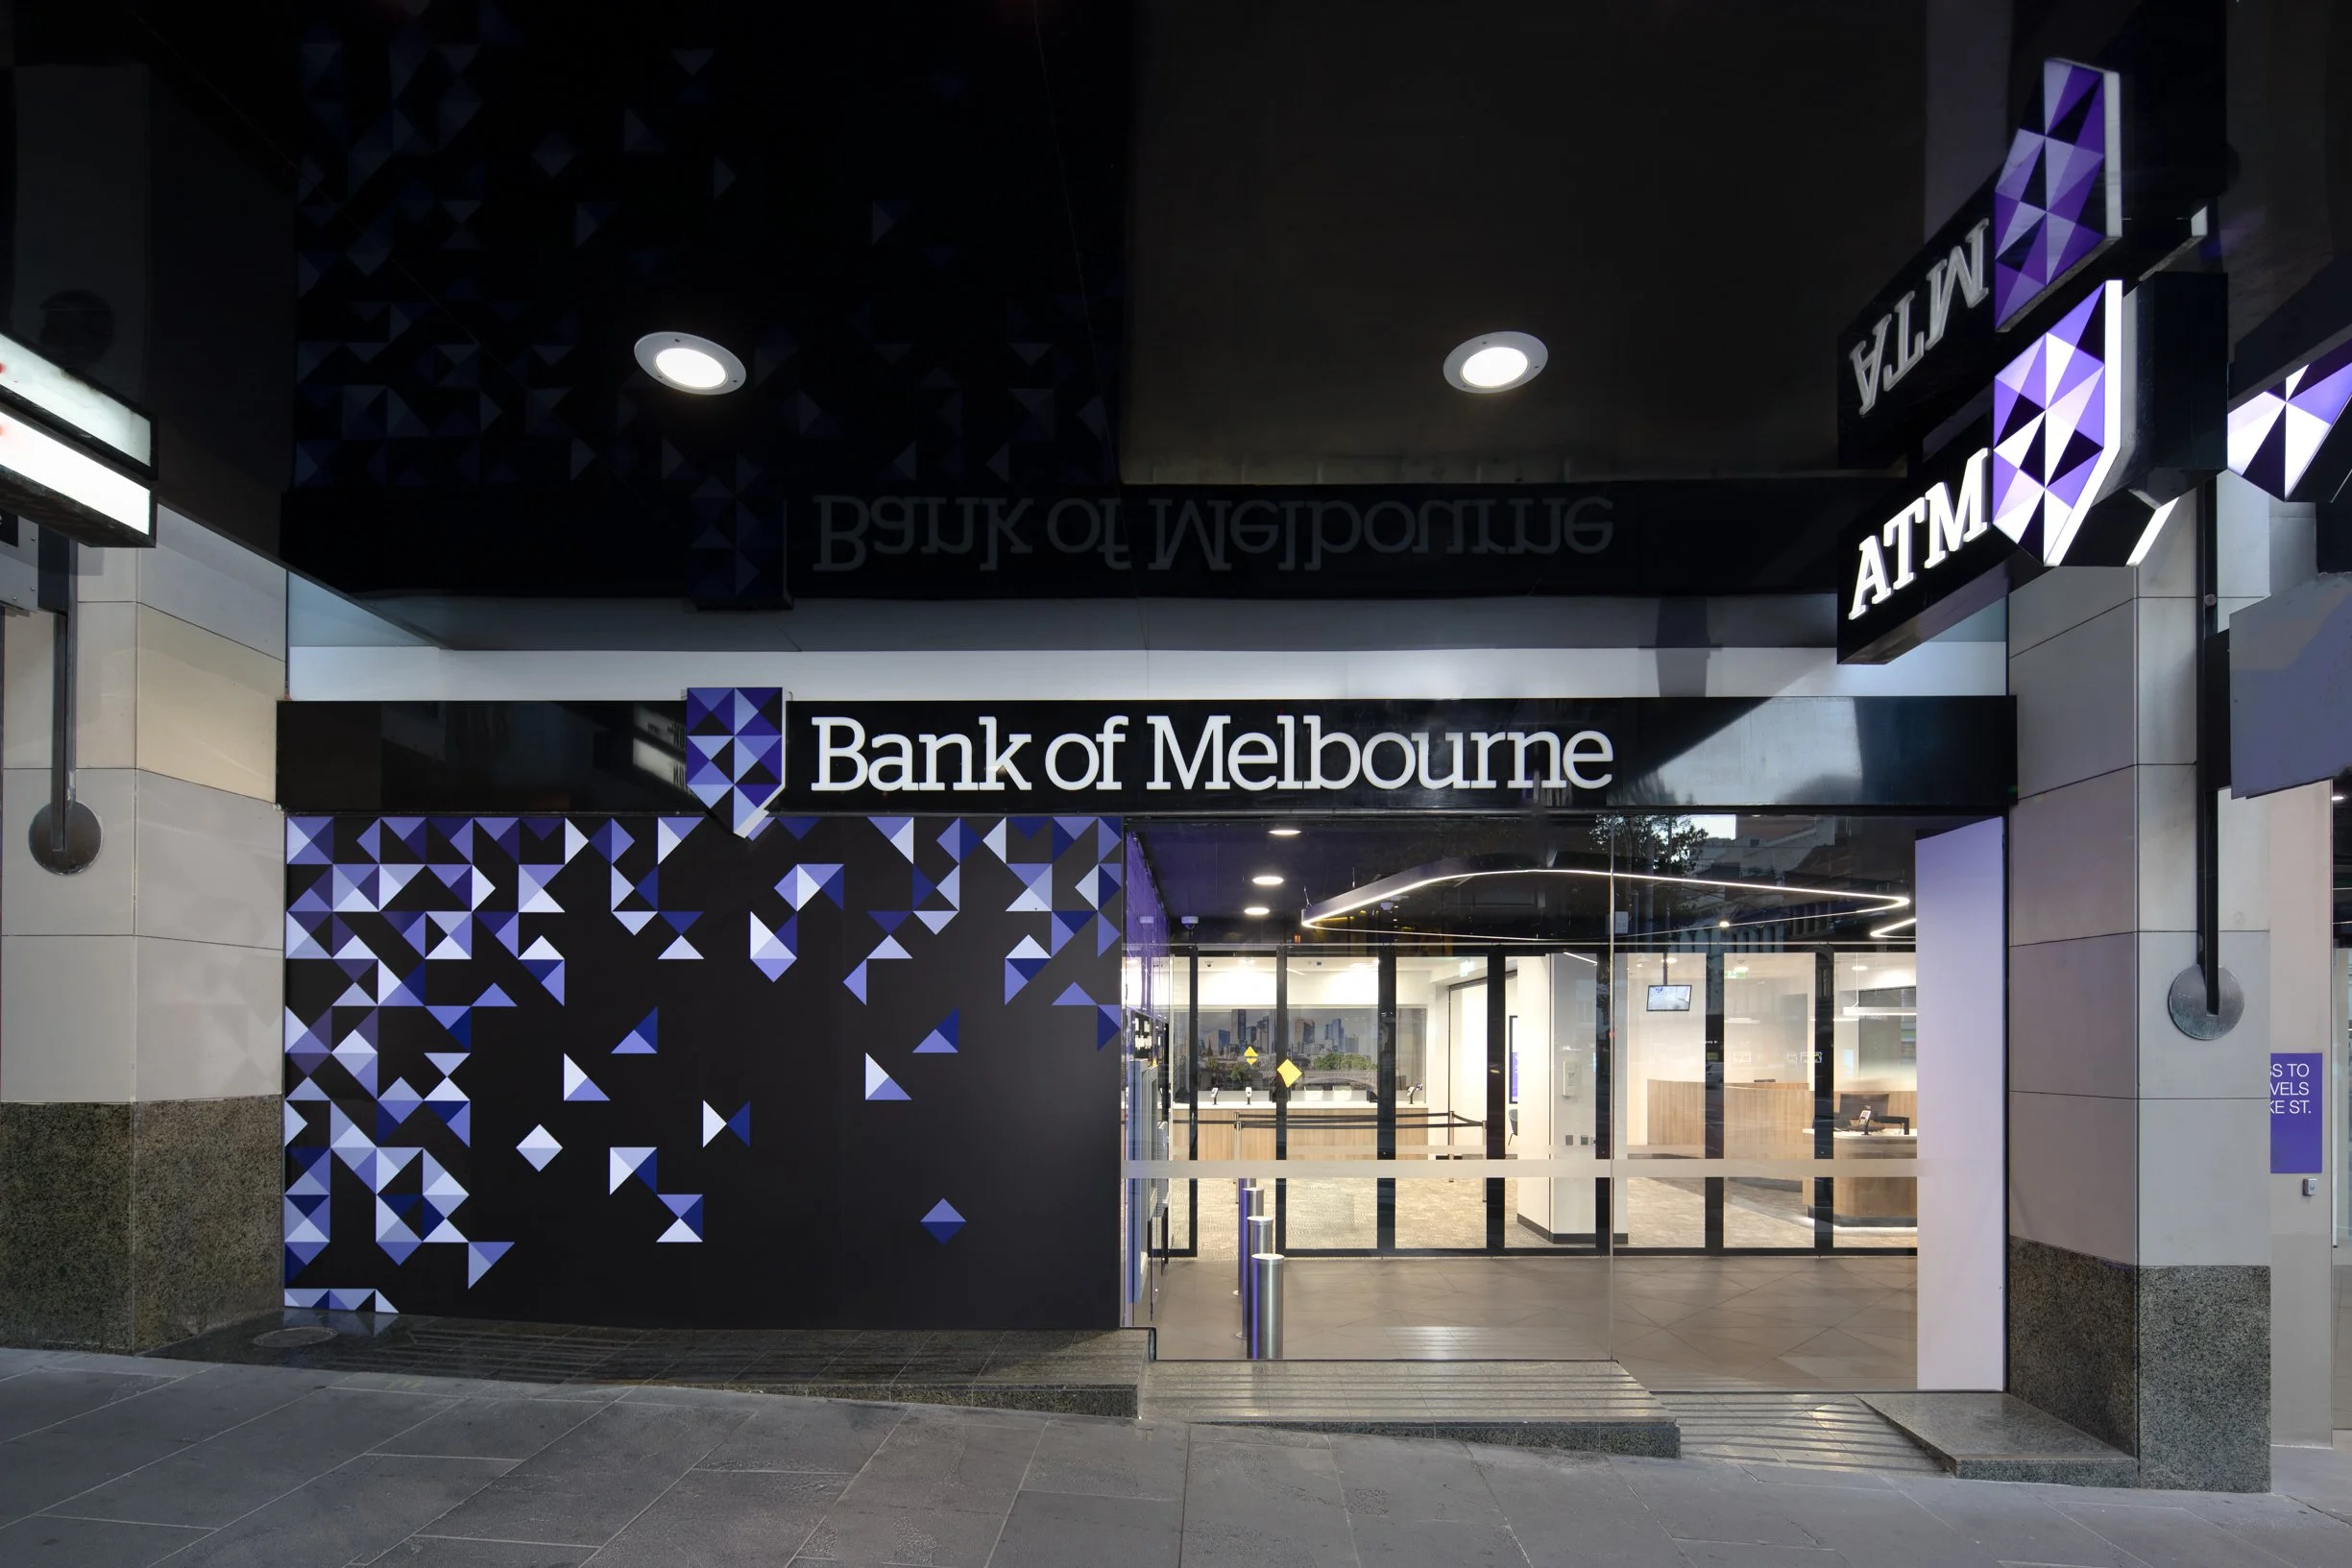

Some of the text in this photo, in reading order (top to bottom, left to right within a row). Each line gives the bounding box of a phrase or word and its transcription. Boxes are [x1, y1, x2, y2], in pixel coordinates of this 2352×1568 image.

[1848, 447, 1989, 620] ATM
[811, 714, 1614, 791] Bank of Melbourne
[2269, 1063, 2310, 1077] S TO
[2289, 1099, 2312, 1114] ST.
